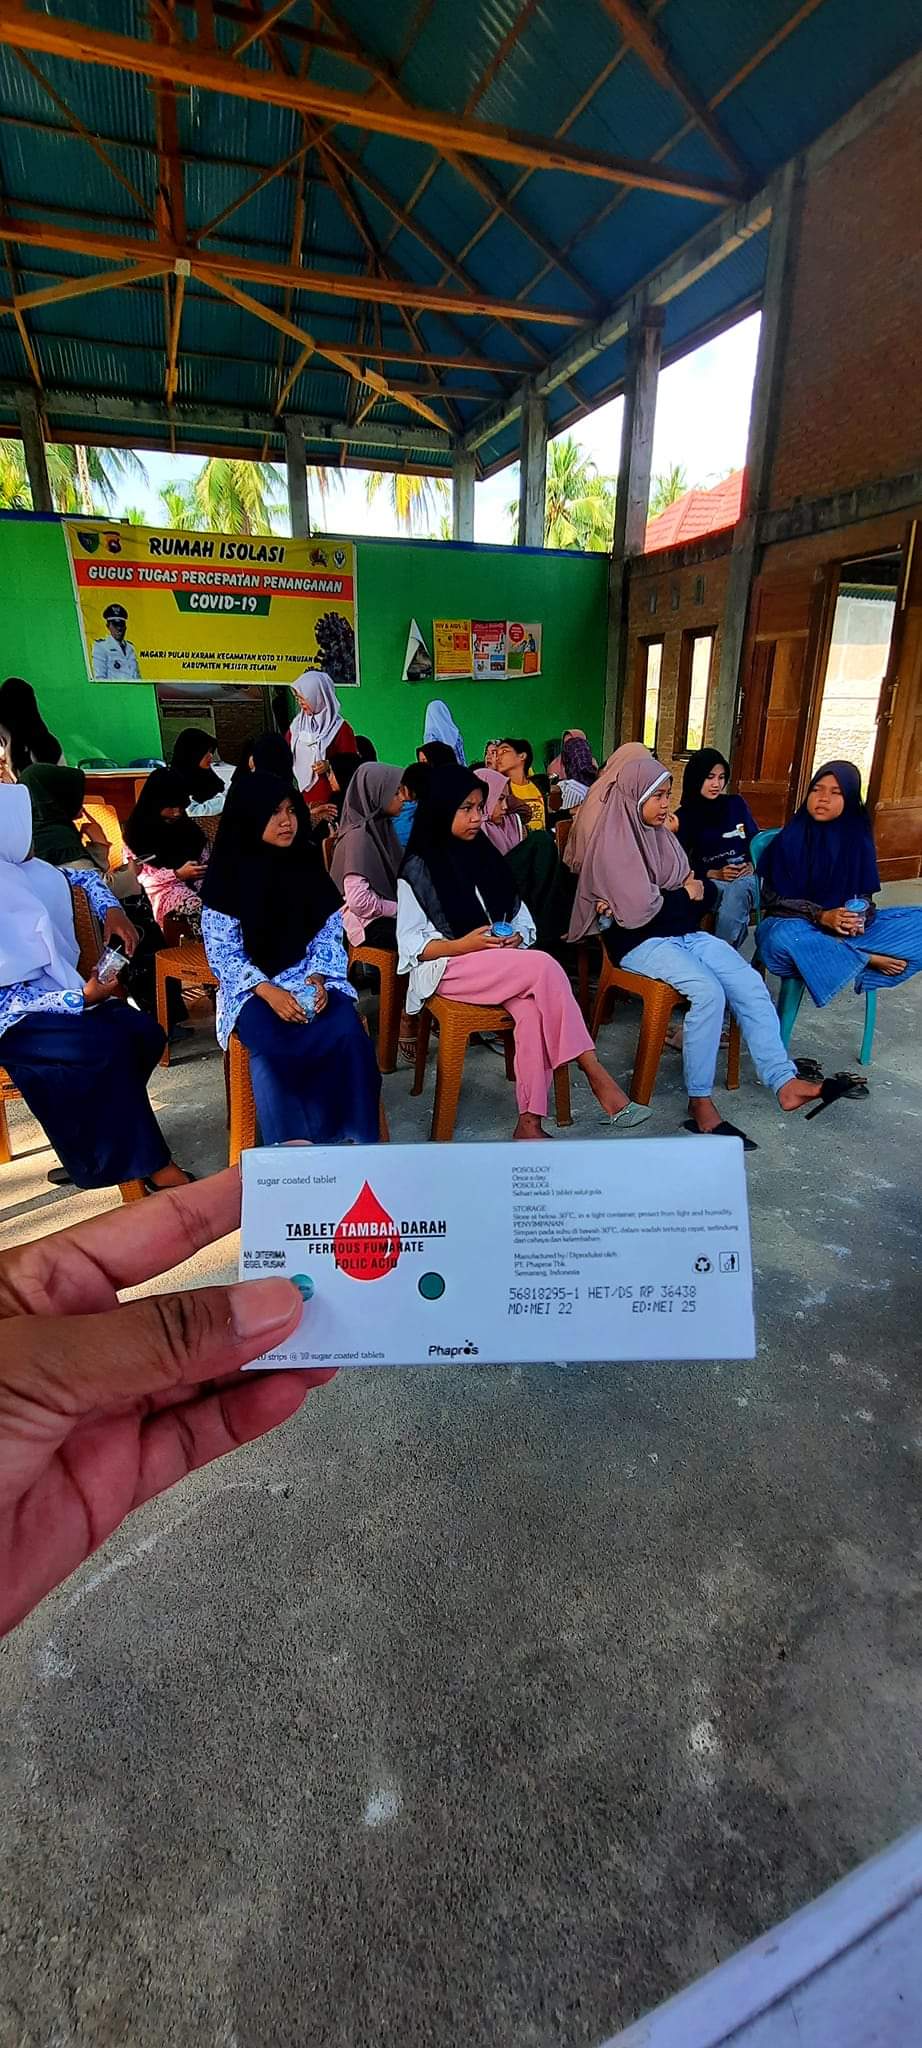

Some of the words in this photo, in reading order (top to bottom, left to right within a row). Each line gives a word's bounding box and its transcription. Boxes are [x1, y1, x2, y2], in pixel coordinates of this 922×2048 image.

[149, 537, 214, 559] RUMAH
[219, 542, 285, 563] ISOLASI
[88, 566, 133, 581] GUGUS
[138, 570, 177, 584] TUGAS
[181, 572, 260, 588] PERCEPATAN
[263, 577, 343, 593] PENANGANAN
[189, 593, 257, 612] COVID-19
[140, 650, 167, 659] NAGARI
[168, 651, 190, 659] PULAU
[191, 652, 216, 660] KARAM
[217, 653, 256, 662] KECAMATAN
[257, 654, 275, 662] KOTO
[285, 655, 314, 664] TARUSAN
[182, 661, 221, 670] KABUPATEN
[250, 664, 277, 672] SELATAN
[257, 1178, 280, 1186] sugar
[282, 1176, 311, 1185] coated
[313, 1175, 337, 1184] tablet
[286, 1223, 335, 1236] TABLET
[340, 1222, 400, 1237] TAMBAH
[401, 1220, 447, 1234] DARAH
[309, 1243, 360, 1254] FERROUS
[364, 1241, 424, 1252] FUMARATE
[335, 1258, 367, 1269] FOLIC
[371, 1257, 398, 1268] ACID
[509, 1287, 579, 1300] 56818295-1
[588, 1286, 633, 1299] HET/DS
[639, 1286, 655, 1298] RP
[660, 1285, 697, 1298] 36438
[507, 1302, 550, 1315] MD:MEI
[558, 1302, 573, 1314] 22
[632, 1301, 673, 1313] ED:MEI
[681, 1300, 697, 1313] 25
[268, 1353, 288, 1362] strips
[311, 1352, 332, 1361] sugar
[333, 1350, 359, 1360] coated
[360, 1349, 385, 1359] tablets
[428, 1341, 479, 1357] Phapros
